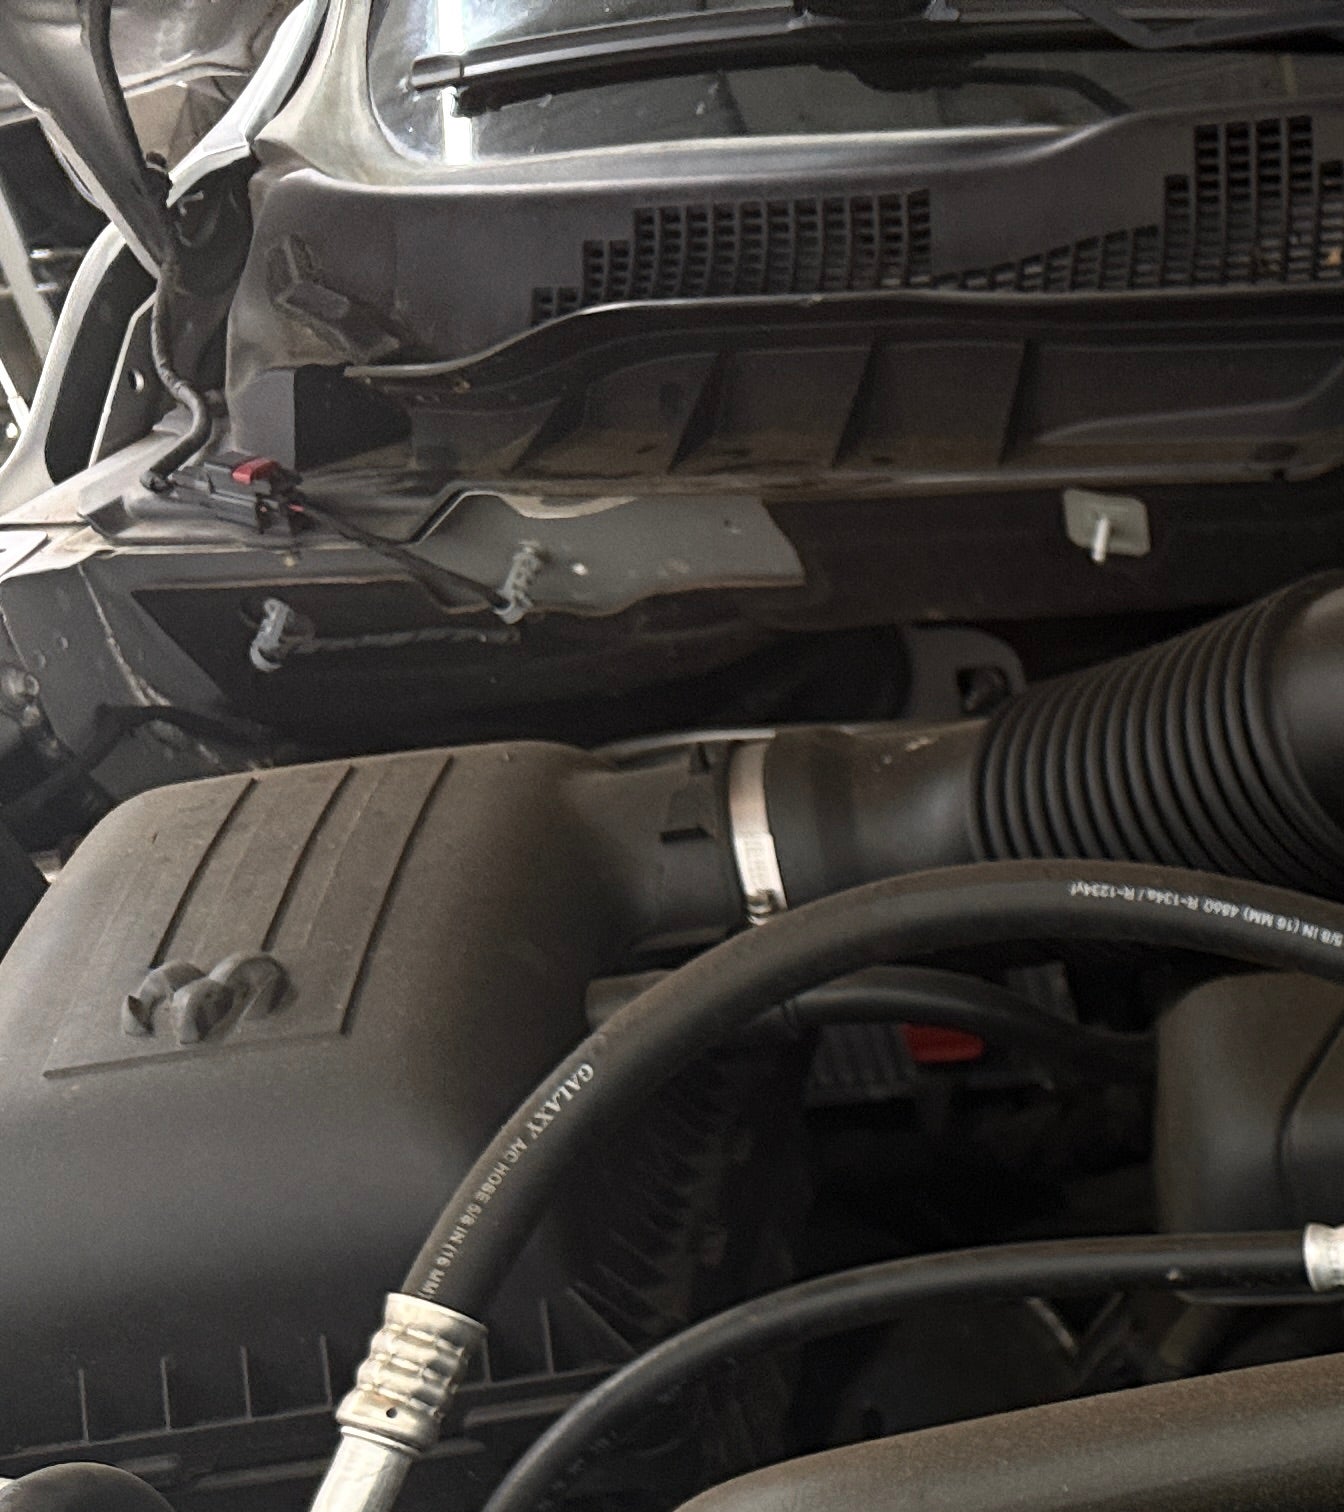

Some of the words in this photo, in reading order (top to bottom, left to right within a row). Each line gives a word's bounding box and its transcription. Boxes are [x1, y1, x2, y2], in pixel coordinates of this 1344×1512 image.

[1243, 906, 1274, 928] MM)
[1302, 924, 1318, 940] IN
[525, 1063, 594, 1140] GALAXY
[503, 1137, 528, 1164] A/C
[474, 1161, 511, 1204] HOSE
[450, 1225, 469, 1245] IN
